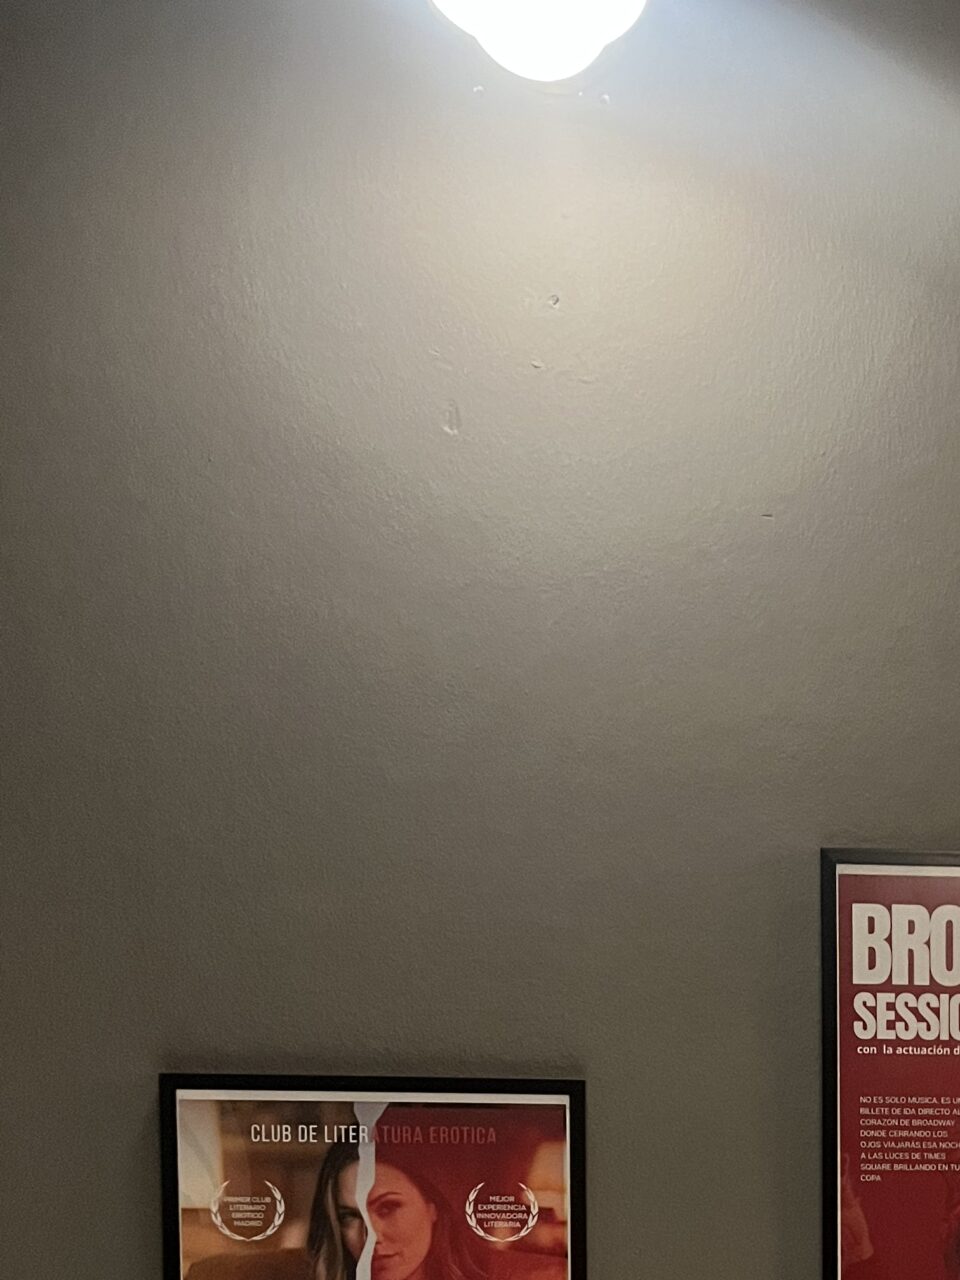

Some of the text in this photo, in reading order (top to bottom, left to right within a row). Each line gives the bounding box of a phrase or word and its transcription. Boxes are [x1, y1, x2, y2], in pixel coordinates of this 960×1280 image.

[857, 1045, 877, 1054] con
[883, 1044, 893, 1055] la
[896, 1044, 950, 1055] actuación
[859, 1096, 872, 1104] NO
[873, 1096, 883, 1104] ES
[885, 1096, 907, 1104] SOLO
[941, 1096, 951, 1105] ES
[859, 1107, 889, 1115] BILLETE
[891, 1107, 901, 1115] DE
[903, 1107, 916, 1115] IDA
[917, 1108, 951, 1116] DIRECTO
[899, 1118, 910, 1127] DE
[911, 1118, 955, 1127] BROADWAY
[251, 1124, 497, 1144] CLUB DE LITERATURA EROTICA
[860, 1129, 948, 1138] DONDE CERRANDO LOS
[860, 1140, 881, 1149] OJOS
[922, 1141, 938, 1149] ESA
[860, 1152, 946, 1160] A LAS LUCES DE TIMES
[860, 1163, 960, 1172] SQUARE BRILLANDO EN TU
[860, 1174, 881, 1182] COPA
